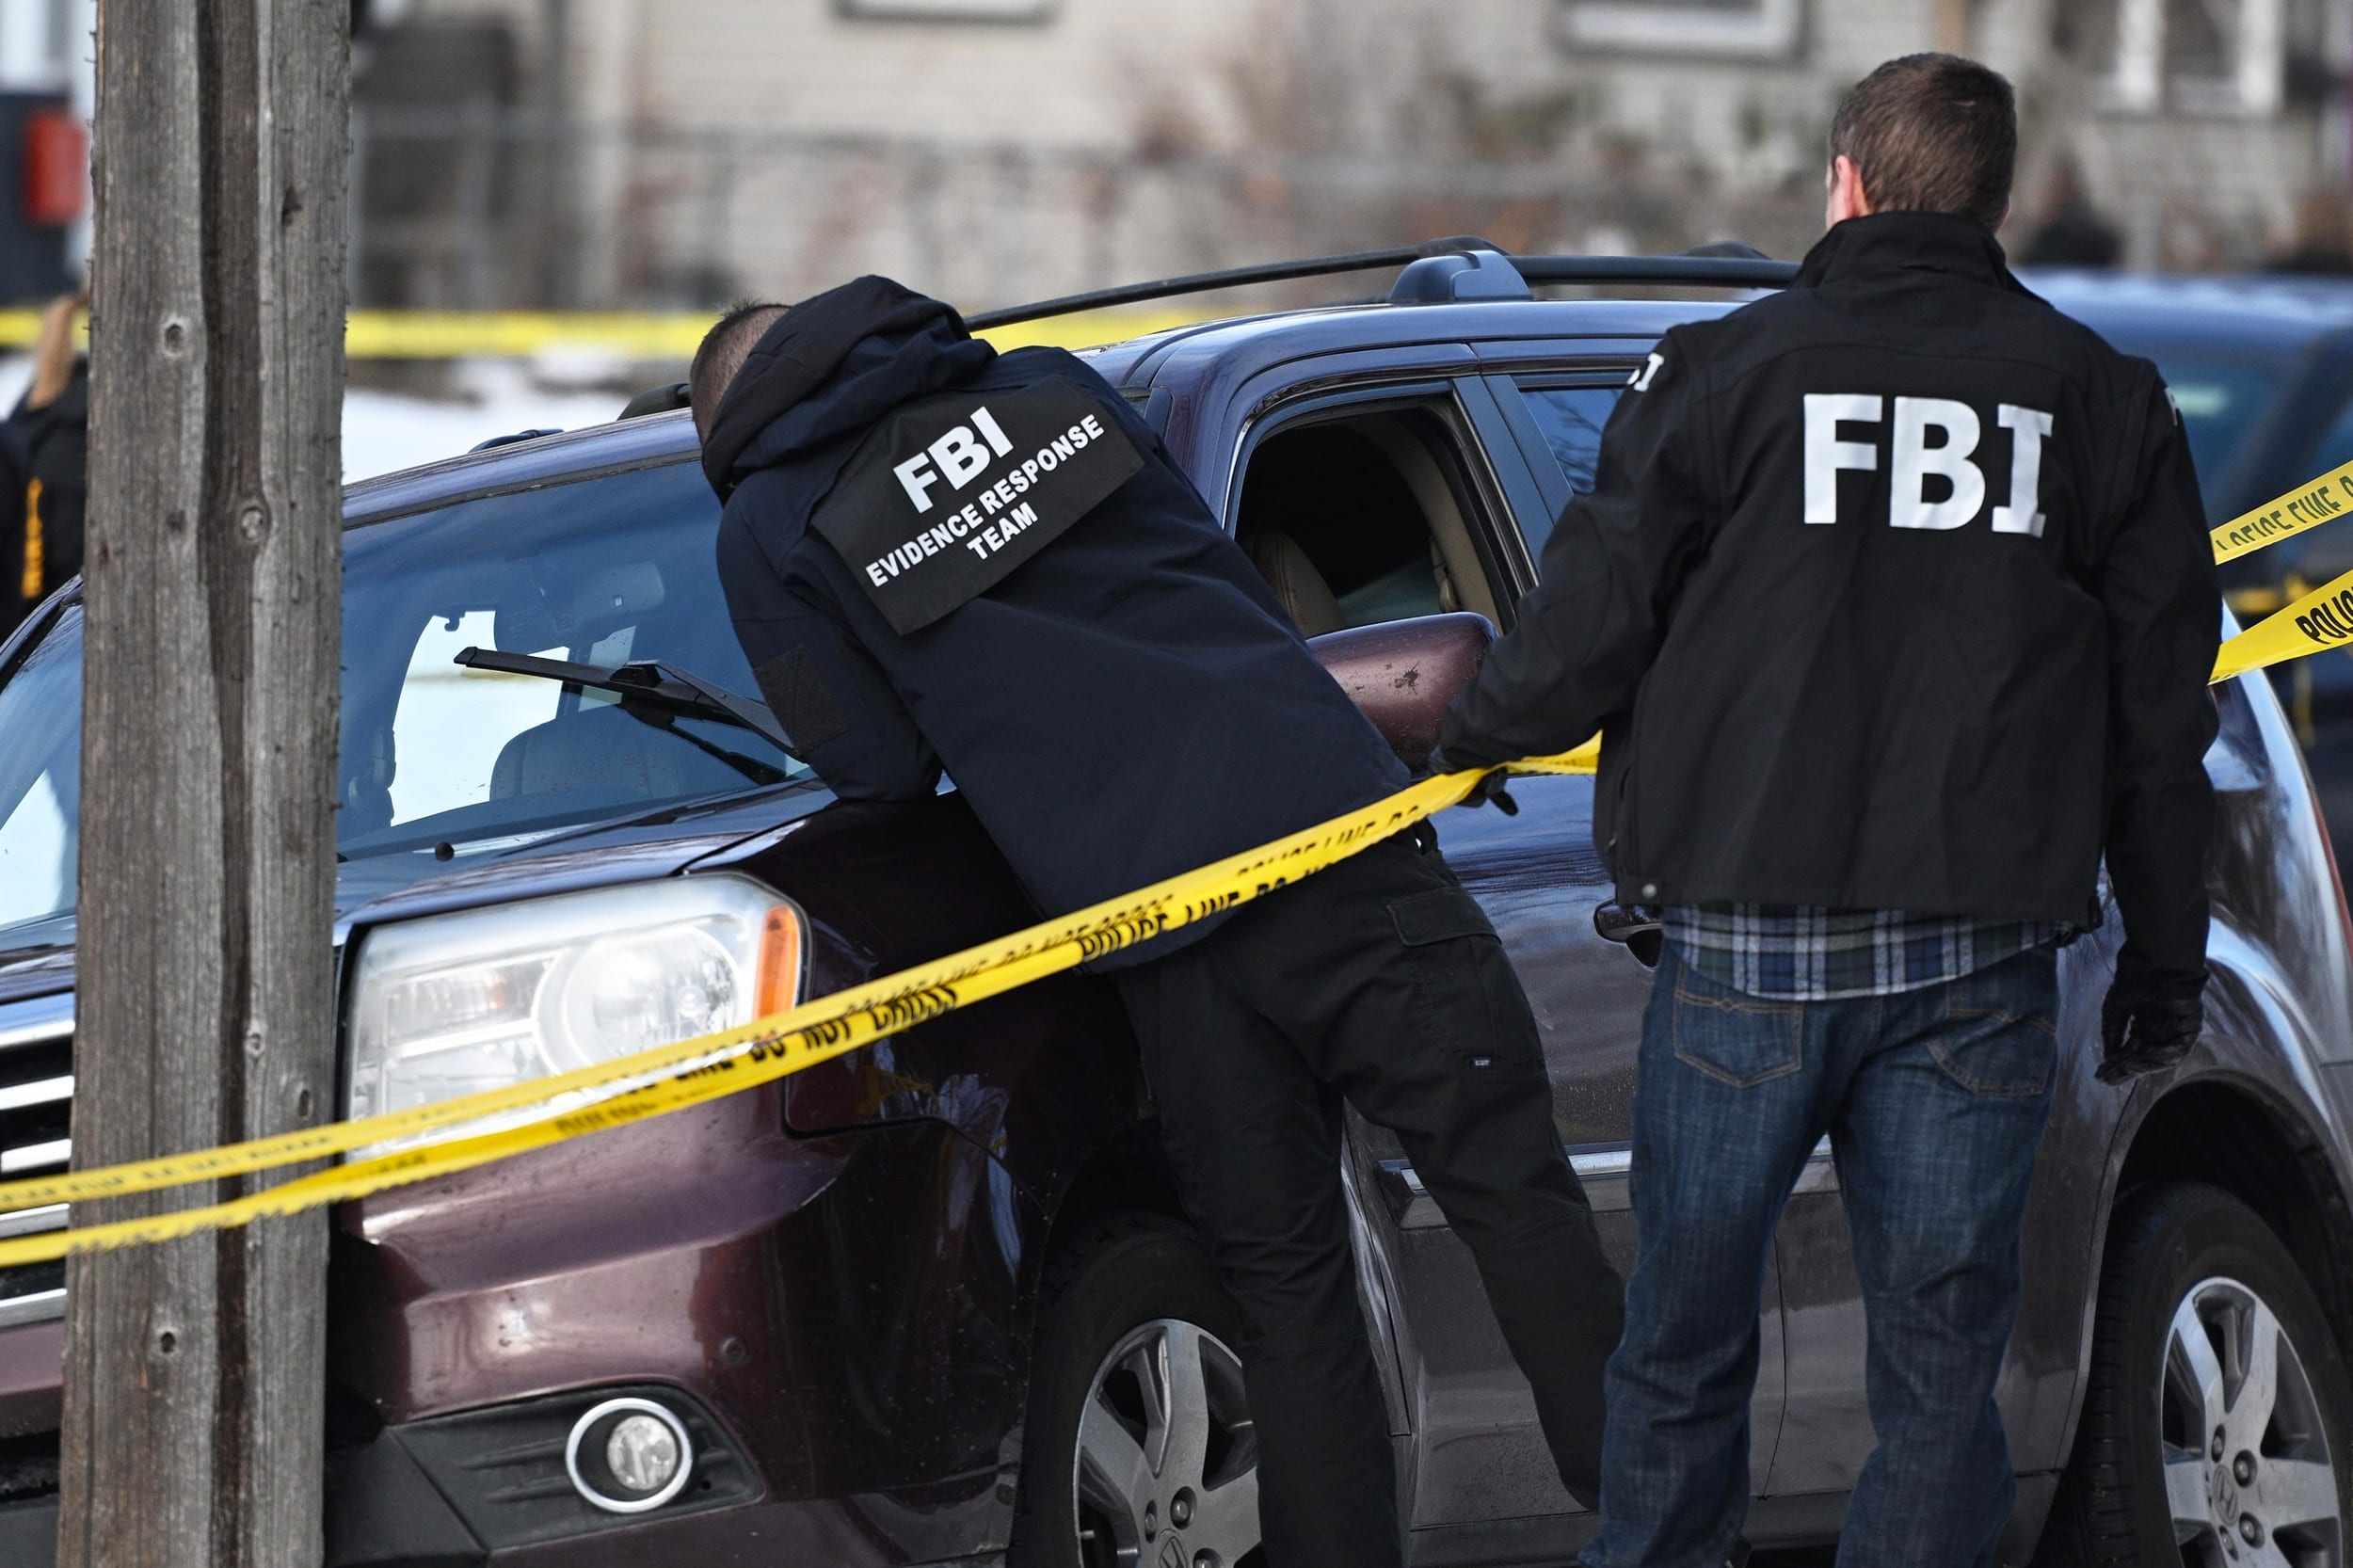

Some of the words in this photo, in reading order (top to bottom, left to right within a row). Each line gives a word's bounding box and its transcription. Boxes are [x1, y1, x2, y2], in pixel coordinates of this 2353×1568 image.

[865, 503, 984, 587] EVIDENCE
[979, 414, 1105, 515] RESPONSE
[893, 406, 1014, 514] FBI
[1803, 393, 2054, 538] FBI
[967, 502, 1038, 560] TEAM
[2295, 585, 2353, 645] POLIC
